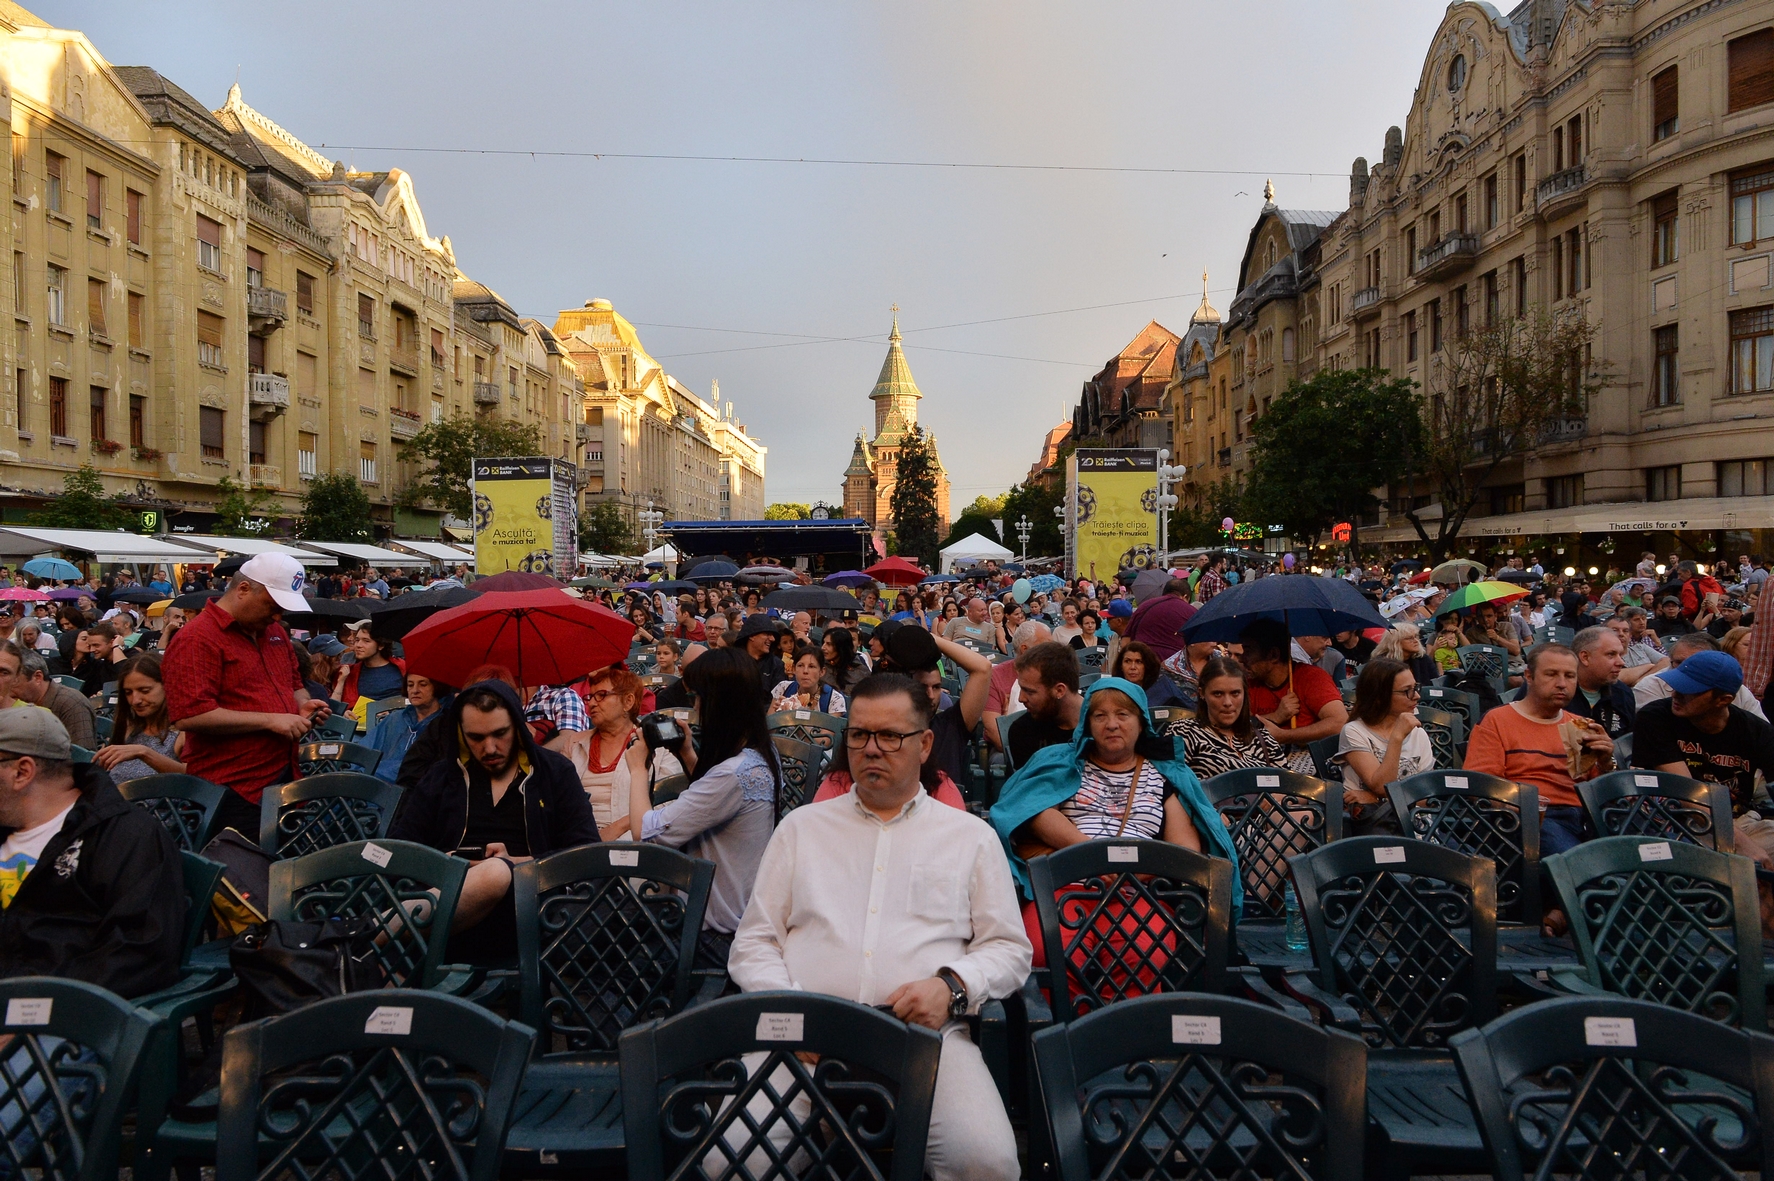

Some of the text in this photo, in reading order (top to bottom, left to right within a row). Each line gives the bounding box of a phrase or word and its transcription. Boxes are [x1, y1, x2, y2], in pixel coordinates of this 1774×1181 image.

[1126, 521, 1149, 530] clipa,
[1633, 521, 1653, 529] calls
[1656, 521, 1668, 529] for
[492, 528, 536, 538] Ascultă:
